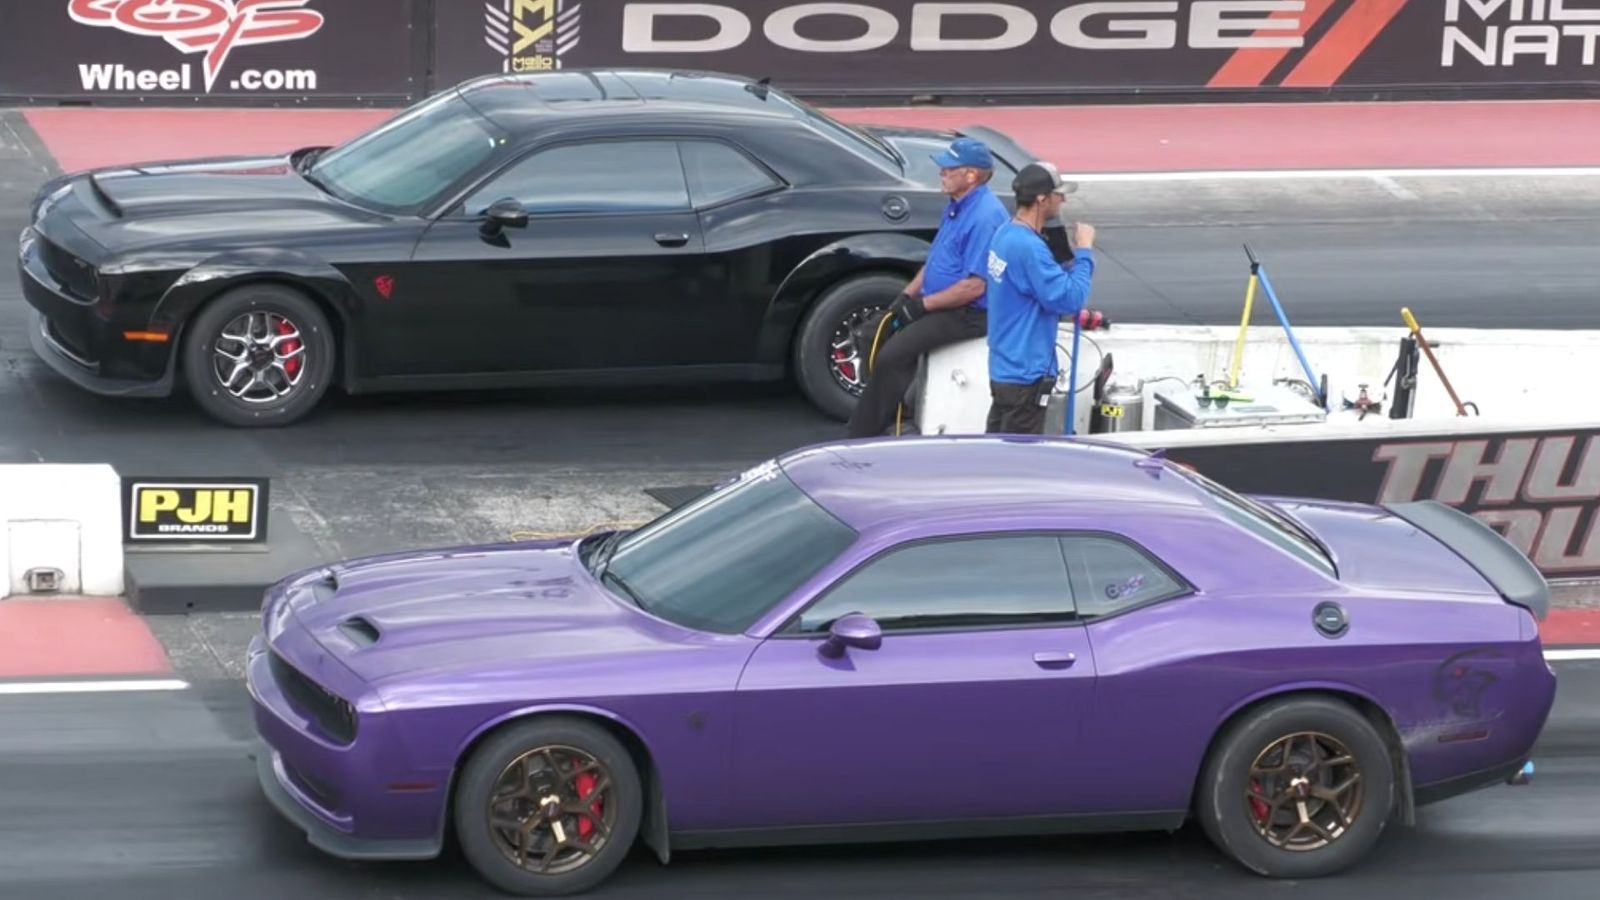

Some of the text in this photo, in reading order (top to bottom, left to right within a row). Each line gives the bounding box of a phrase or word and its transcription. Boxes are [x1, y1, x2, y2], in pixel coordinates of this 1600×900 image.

[622, 2, 1305, 52] DODGE
[78, 63, 317, 90] Wheel .com
[1372, 434, 1600, 504] THU
[139, 489, 250, 523] PJH
[158, 524, 229, 533] BRANDS
